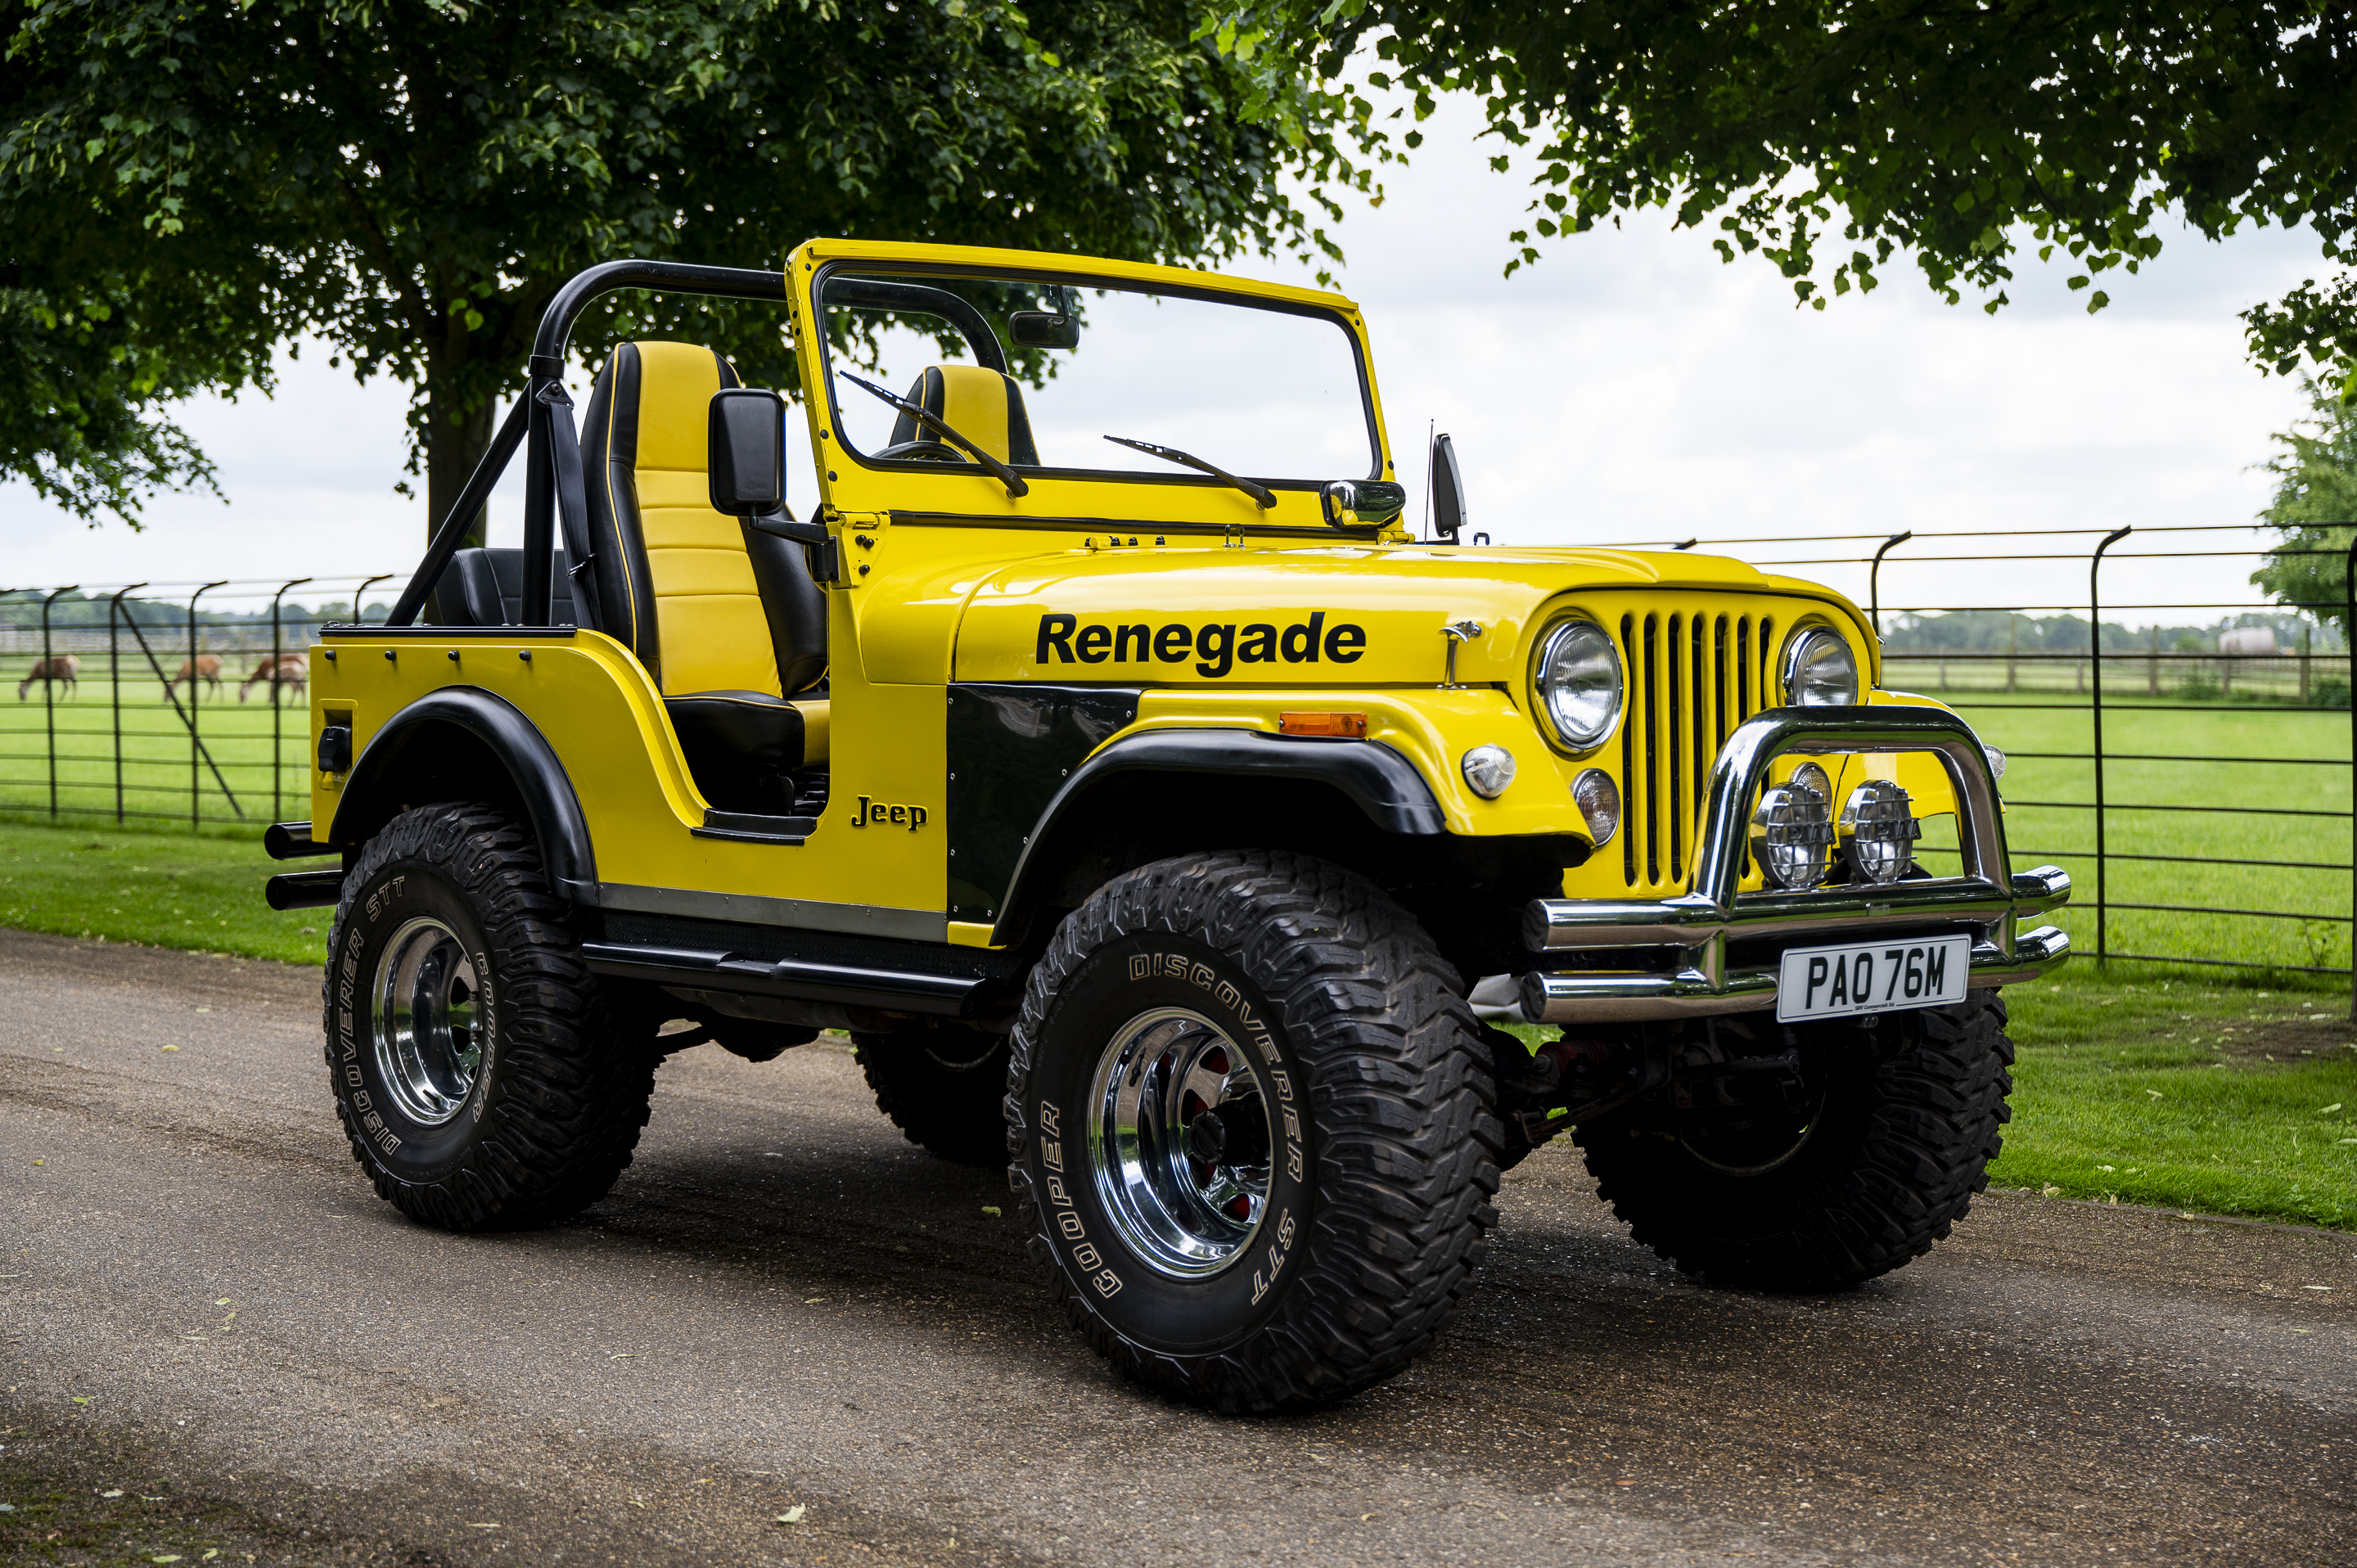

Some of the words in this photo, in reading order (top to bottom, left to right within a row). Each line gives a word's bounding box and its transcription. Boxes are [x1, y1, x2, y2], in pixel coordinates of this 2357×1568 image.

[1035, 611, 1367, 678] Renegade
[851, 795, 928, 832] Jeep
[366, 876, 405, 922] STT
[1805, 952, 1873, 1010] PAO
[1884, 945, 1947, 1001] 76M
[339, 927, 402, 1156] DISCOVERER
[472, 952, 496, 1124] COOPER
[1129, 953, 1303, 1183] DISCOVERER
[1251, 1207, 1296, 1306] STT
[1040, 1099, 1124, 1299] COOPER
